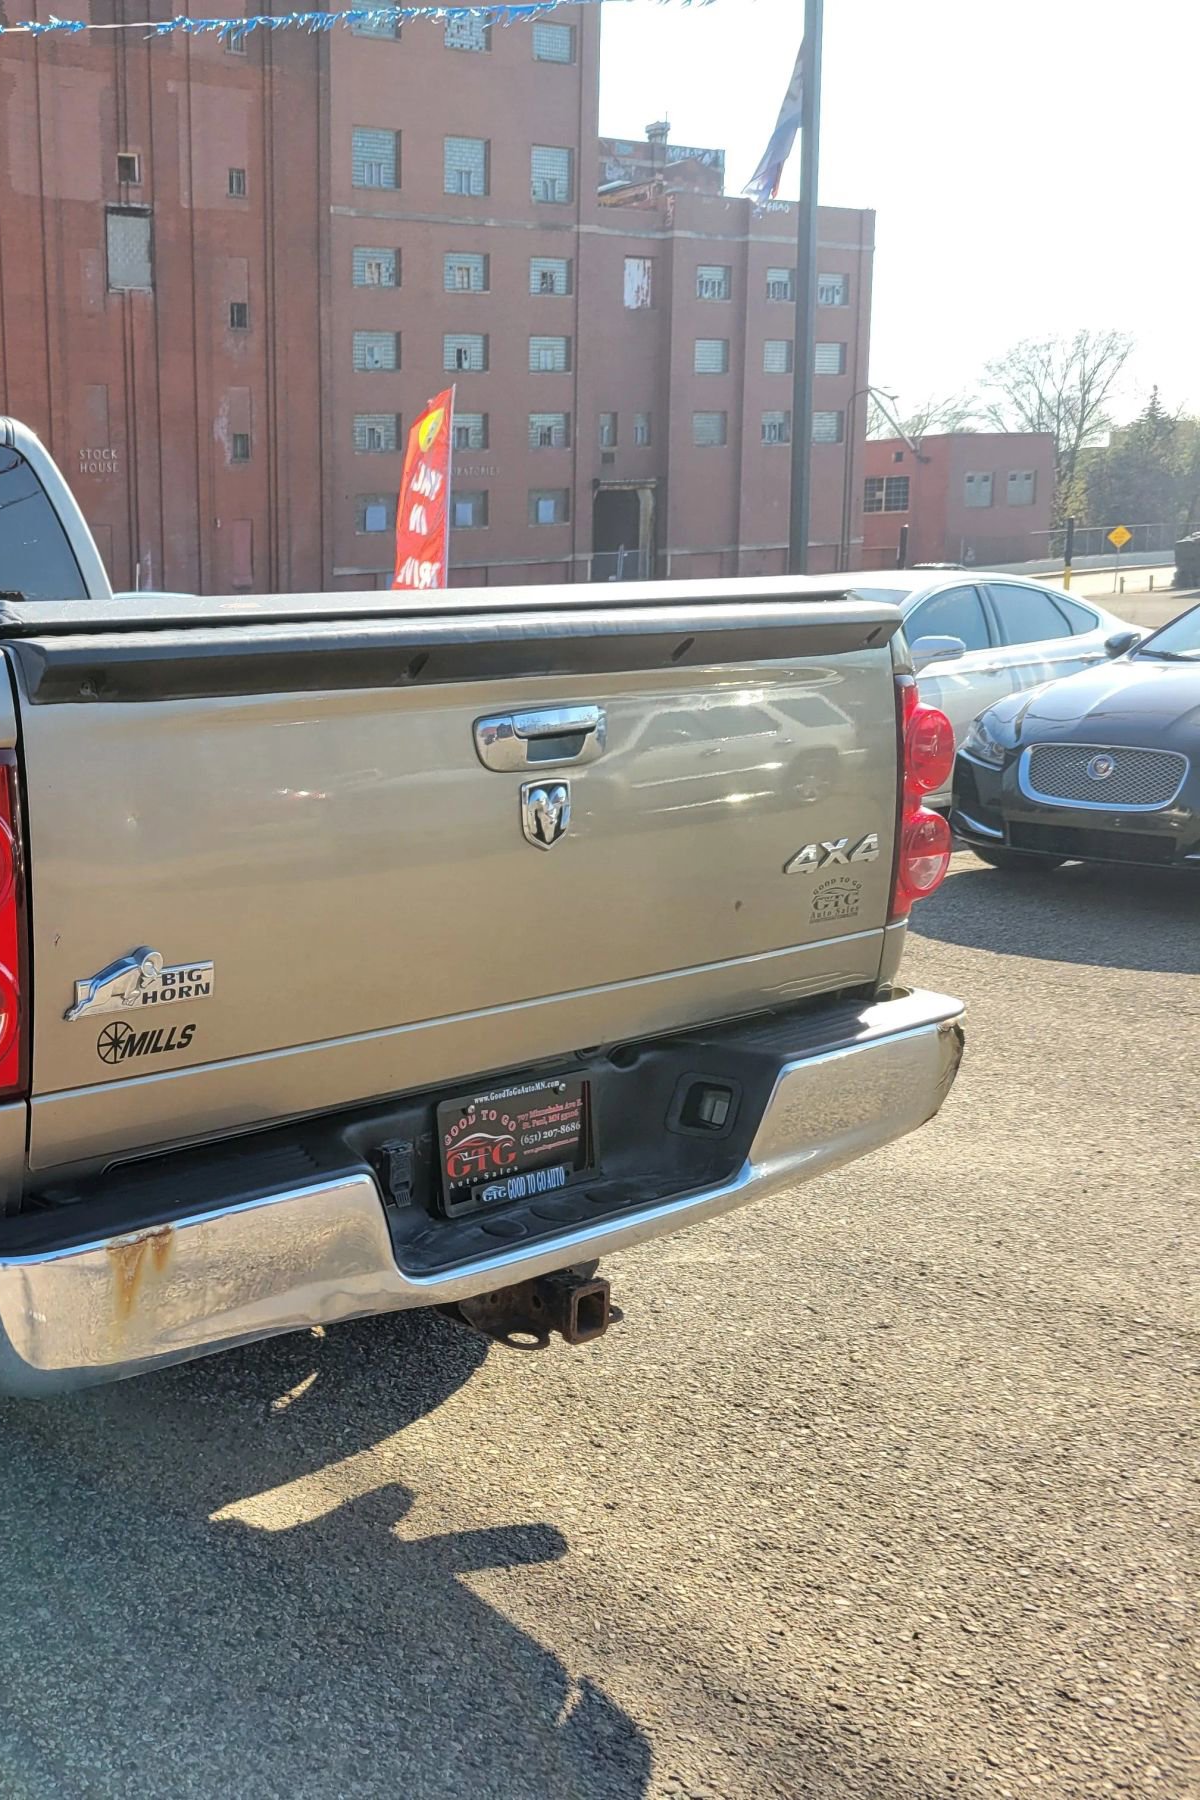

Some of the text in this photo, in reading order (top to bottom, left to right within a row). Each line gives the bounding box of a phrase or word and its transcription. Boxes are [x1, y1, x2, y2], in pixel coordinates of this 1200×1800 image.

[79, 448, 118, 460] STOCK
[80, 462, 120, 473] HOUSE
[810, 911, 832, 919] Auto
[836, 905, 859, 914] Sales
[161, 969, 203, 986] BIG
[141, 982, 210, 1005] HORN
[119, 1024, 196, 1059] MILLS
[474, 1080, 560, 1104] www.GoodToGoAutoMN.com
[444, 1109, 517, 1146] GOOD TO GO
[520, 1131, 542, 1146] (651)
[543, 1121, 581, 1140] 207-8686
[449, 1165, 519, 1190] Auto Sales
[507, 1175, 526, 1200] GOOD
[526, 1173, 537, 1194] TO
[537, 1170, 547, 1191] GO
[547, 1166, 565, 1188] AUTO
